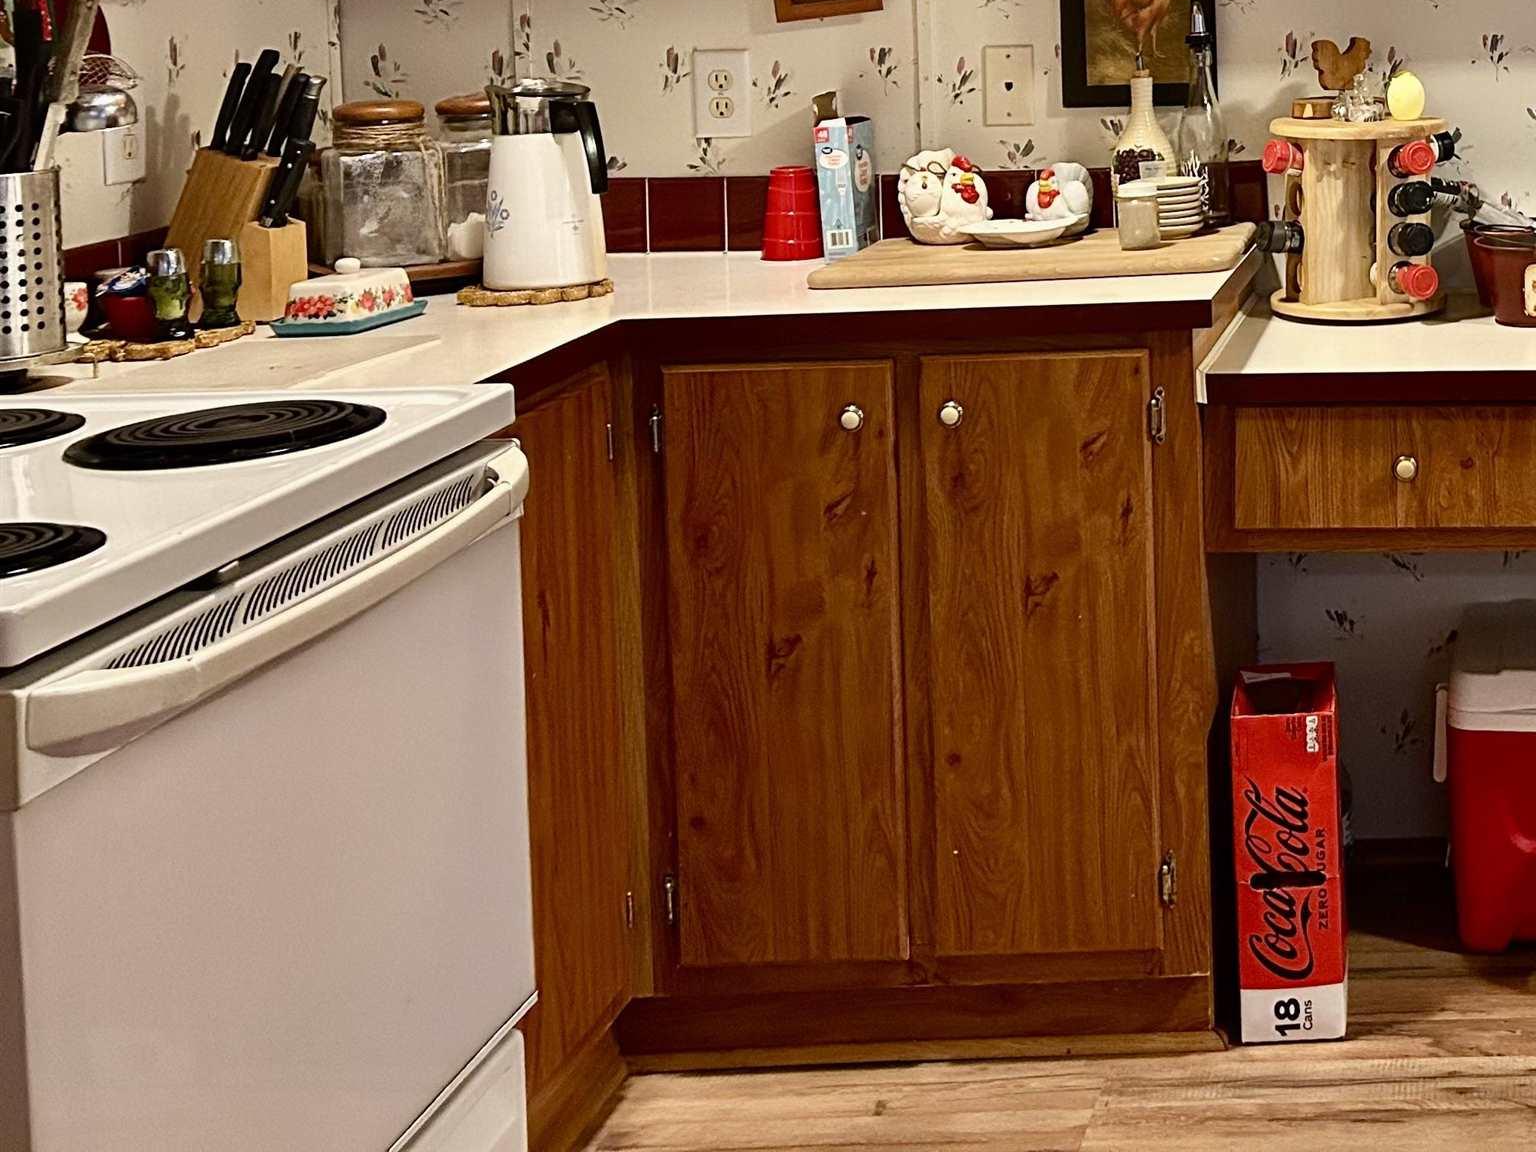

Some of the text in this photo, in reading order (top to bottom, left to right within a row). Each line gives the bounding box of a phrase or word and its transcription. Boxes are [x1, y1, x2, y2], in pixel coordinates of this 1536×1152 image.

[1243, 774, 1314, 981] CocaCola
[1315, 828, 1330, 930] ZERO UGAR
[1274, 997, 1301, 1037] 18
[1302, 999, 1313, 1031] Cans
